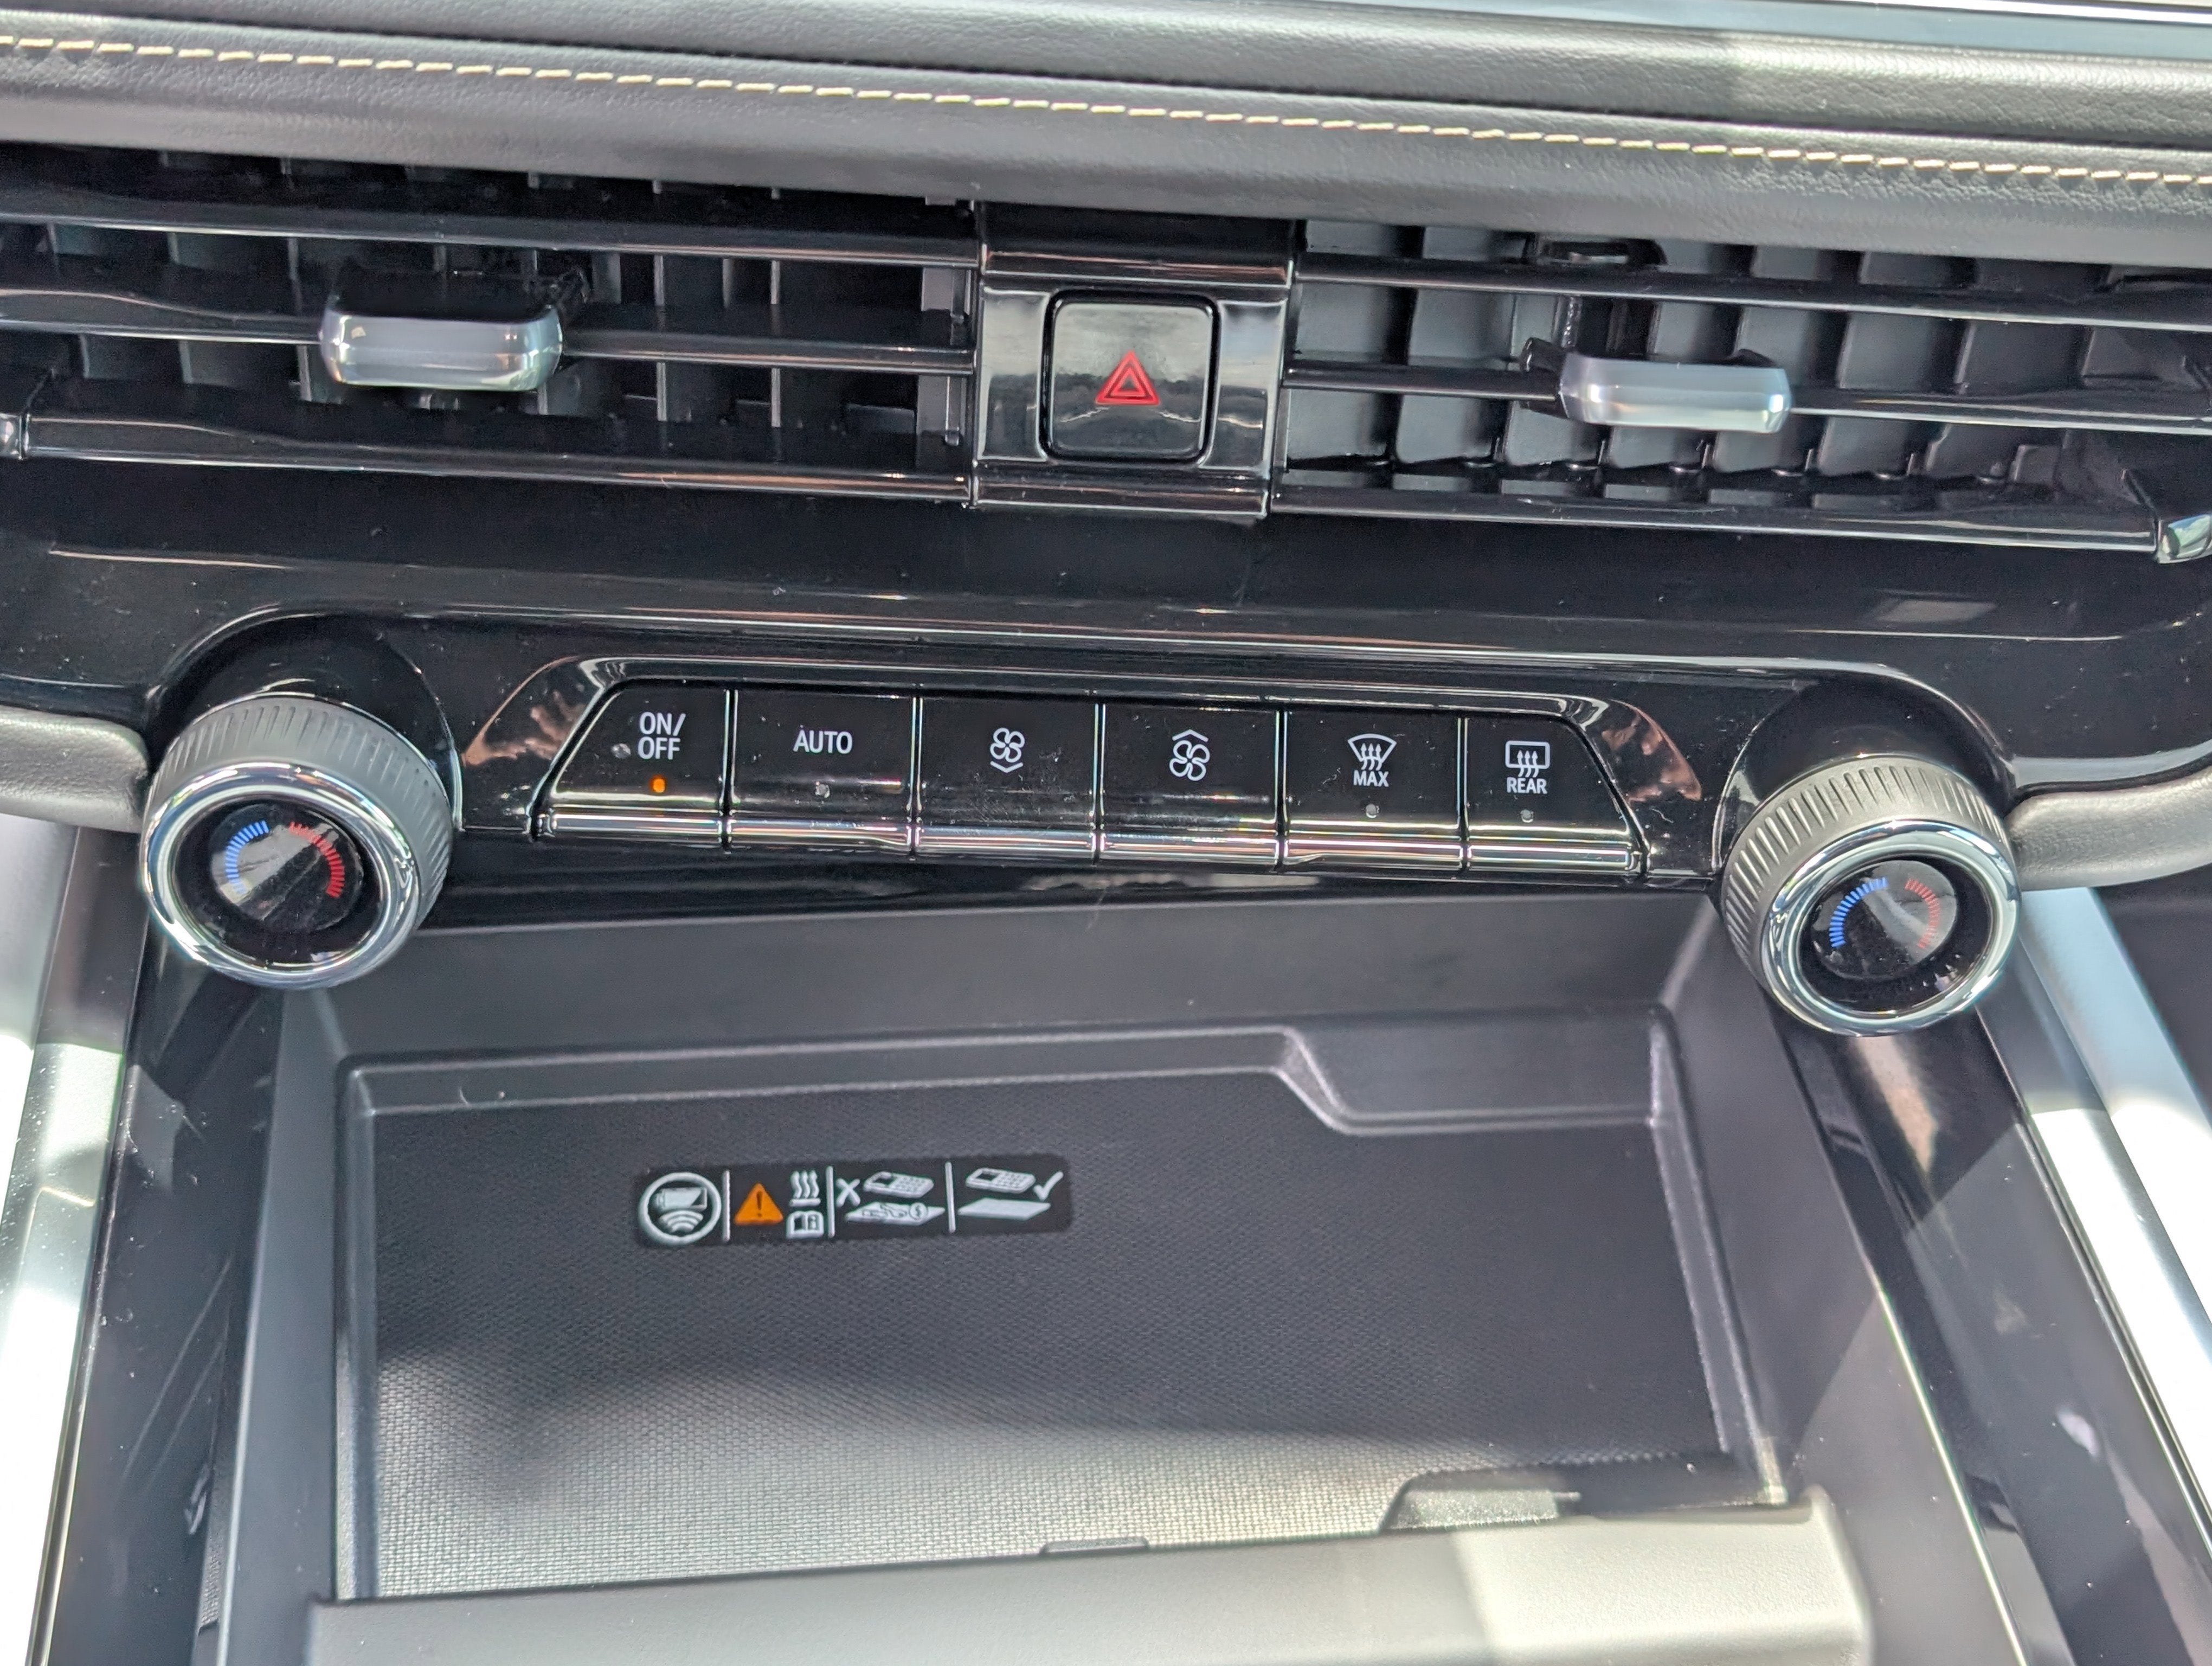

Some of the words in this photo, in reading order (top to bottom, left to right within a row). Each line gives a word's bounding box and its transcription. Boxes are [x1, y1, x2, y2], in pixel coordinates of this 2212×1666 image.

[639, 712, 686, 736] ON/
[638, 736, 681, 760] OFF
[793, 730, 853, 753] AUTO
[1353, 770, 1389, 787] MAX
[1507, 777, 1548, 794] REAR
